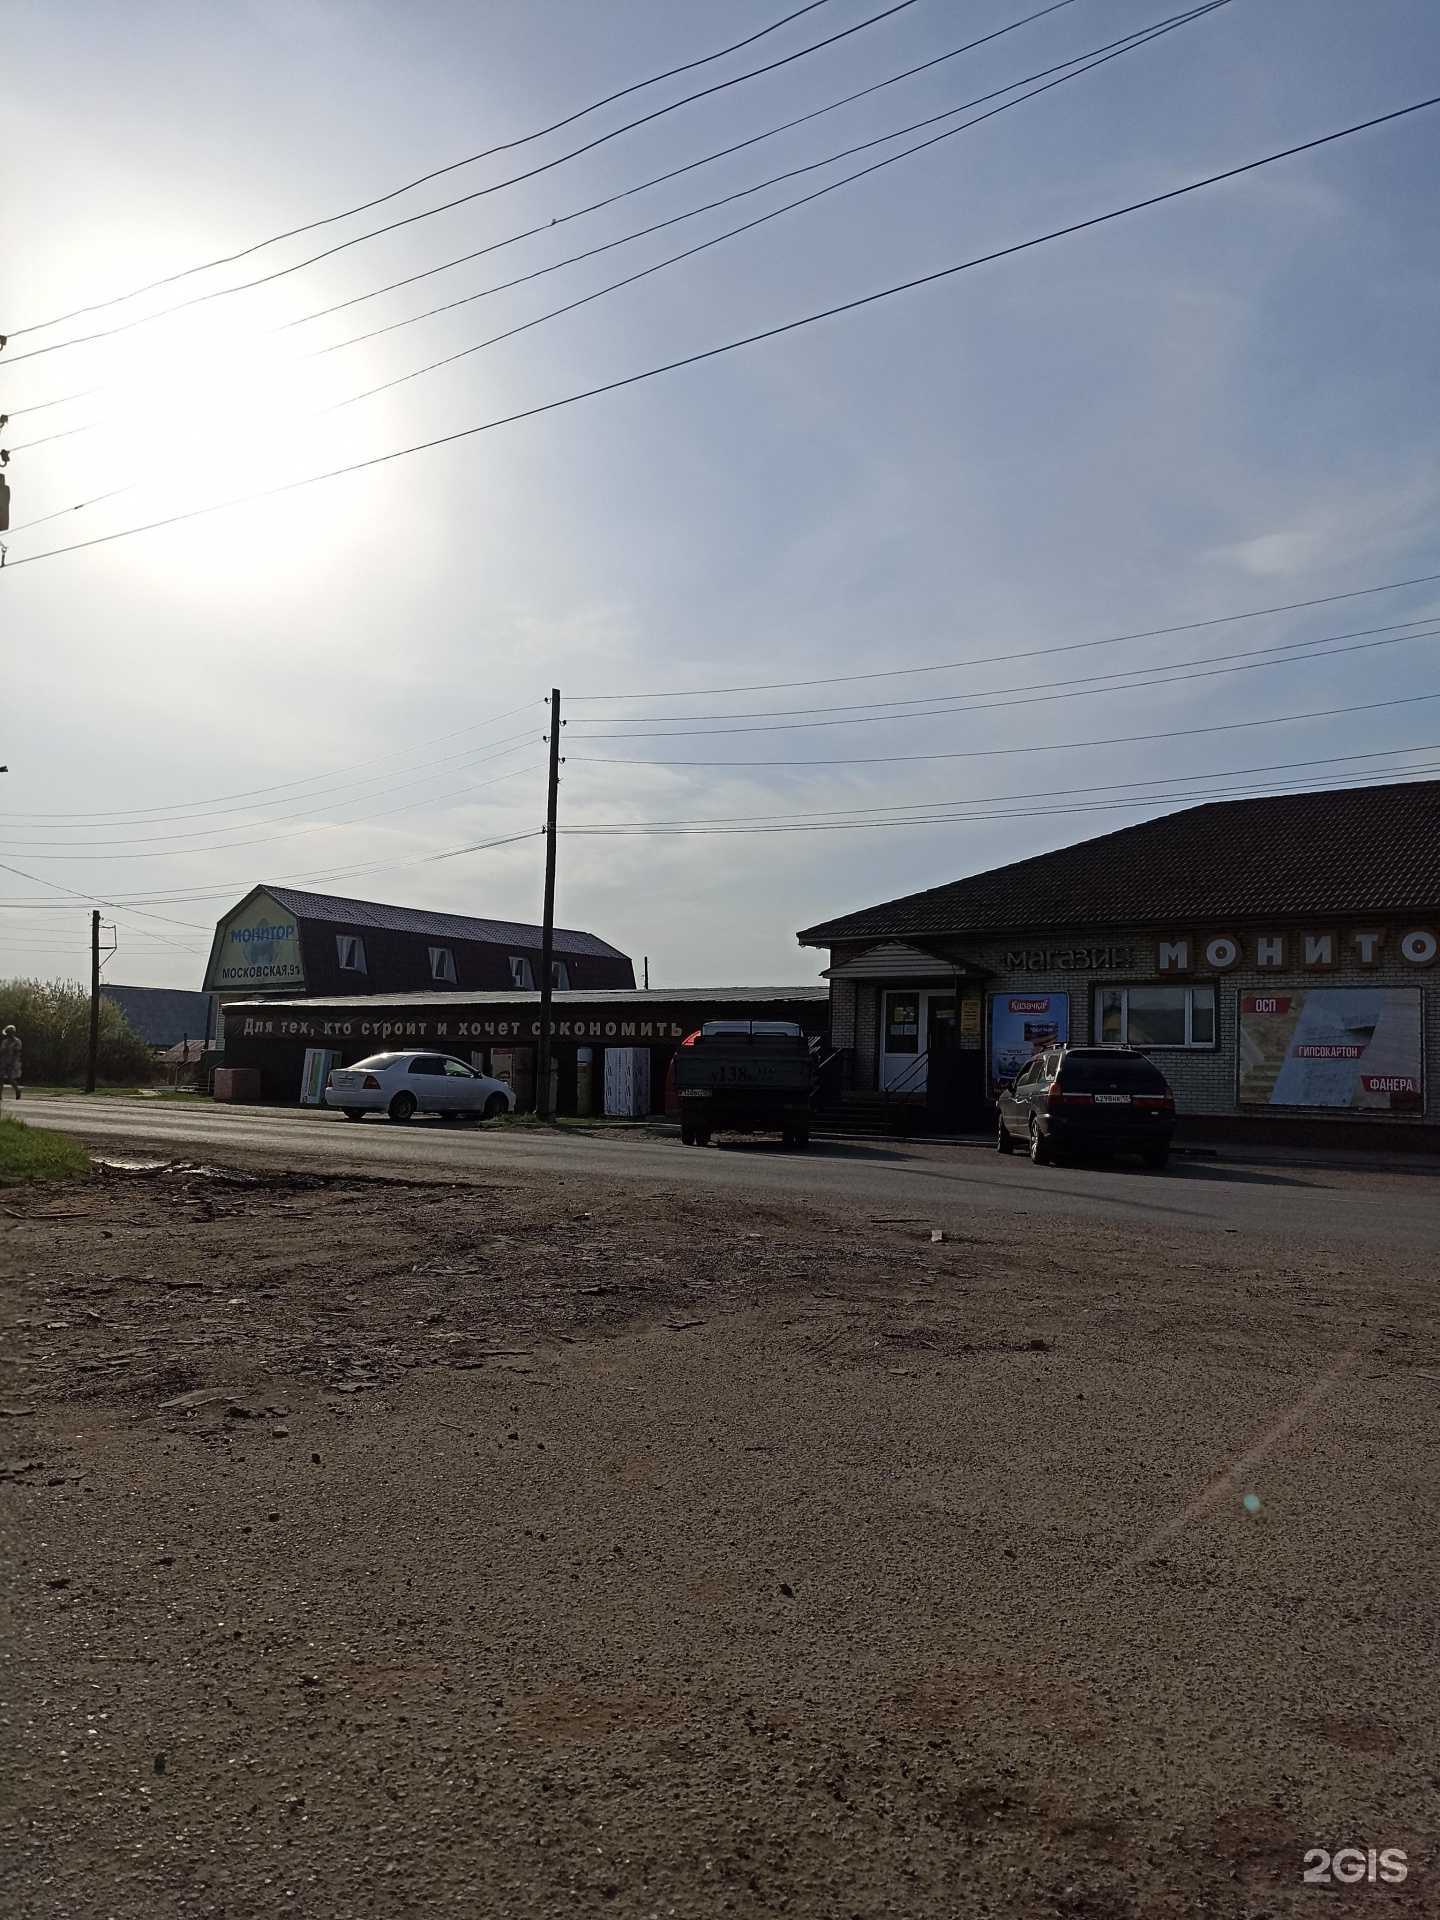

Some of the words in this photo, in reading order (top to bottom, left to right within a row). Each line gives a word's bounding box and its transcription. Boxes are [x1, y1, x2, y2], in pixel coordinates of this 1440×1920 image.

[231, 925, 294, 943] МОНИТОР
[1006, 948, 1133, 971] магазин
[1255, 999, 1277, 1012] ОСП
[243, 1018, 273, 1035] Для
[281, 1020, 315, 1035] тех,
[323, 1020, 351, 1035] кто
[361, 1020, 427, 1039] строит
[437, 1022, 448, 1035] и
[458, 1021, 520, 1036] хочет
[1298, 1046, 1358, 1058] ГИПСОКАРТОН
[1369, 1078, 1414, 1092] ФАНЕРА
